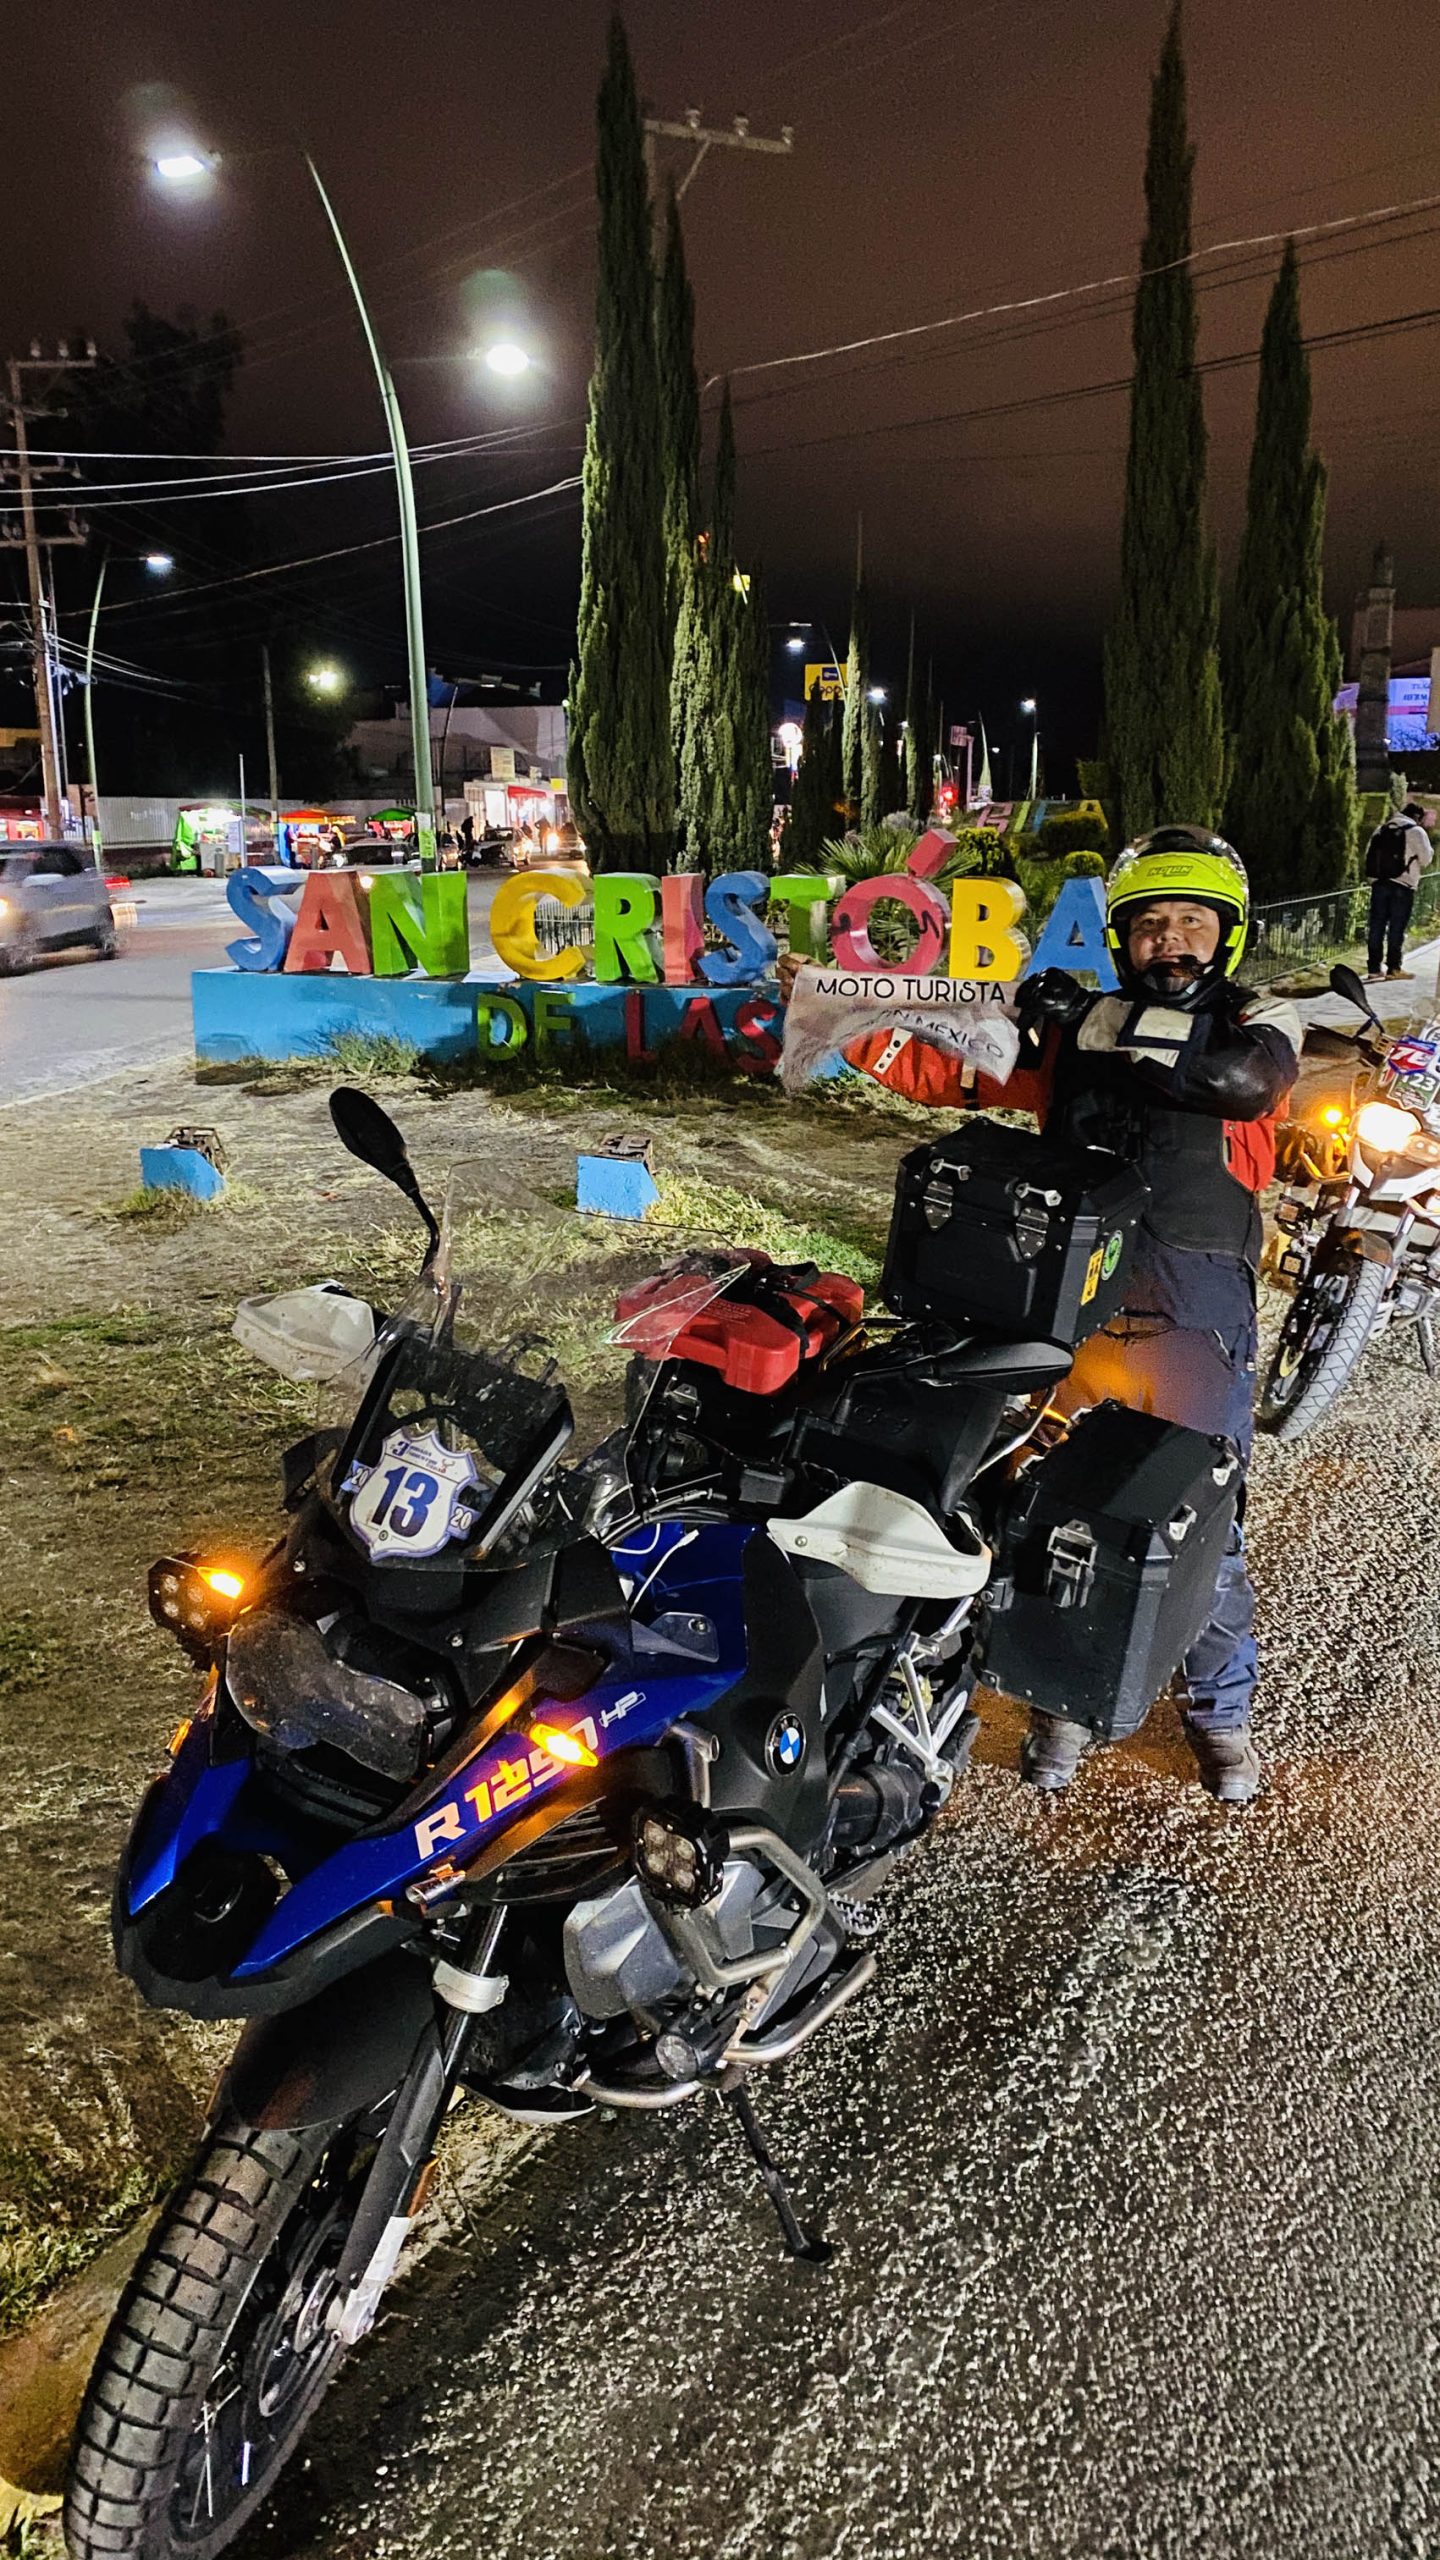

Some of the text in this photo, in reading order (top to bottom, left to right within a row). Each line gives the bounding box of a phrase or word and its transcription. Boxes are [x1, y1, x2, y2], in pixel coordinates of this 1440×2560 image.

[225, 828, 1122, 993] SAN CRISTÓBA
[816, 978, 1006, 1004] MOTO TURISTA
[477, 992, 784, 1075] DE LAS
[371, 1466, 439, 1537] 13
[450, 1506, 473, 1530] 20
[414, 1801, 467, 1860] R
[599, 1690, 647, 1729] HP
